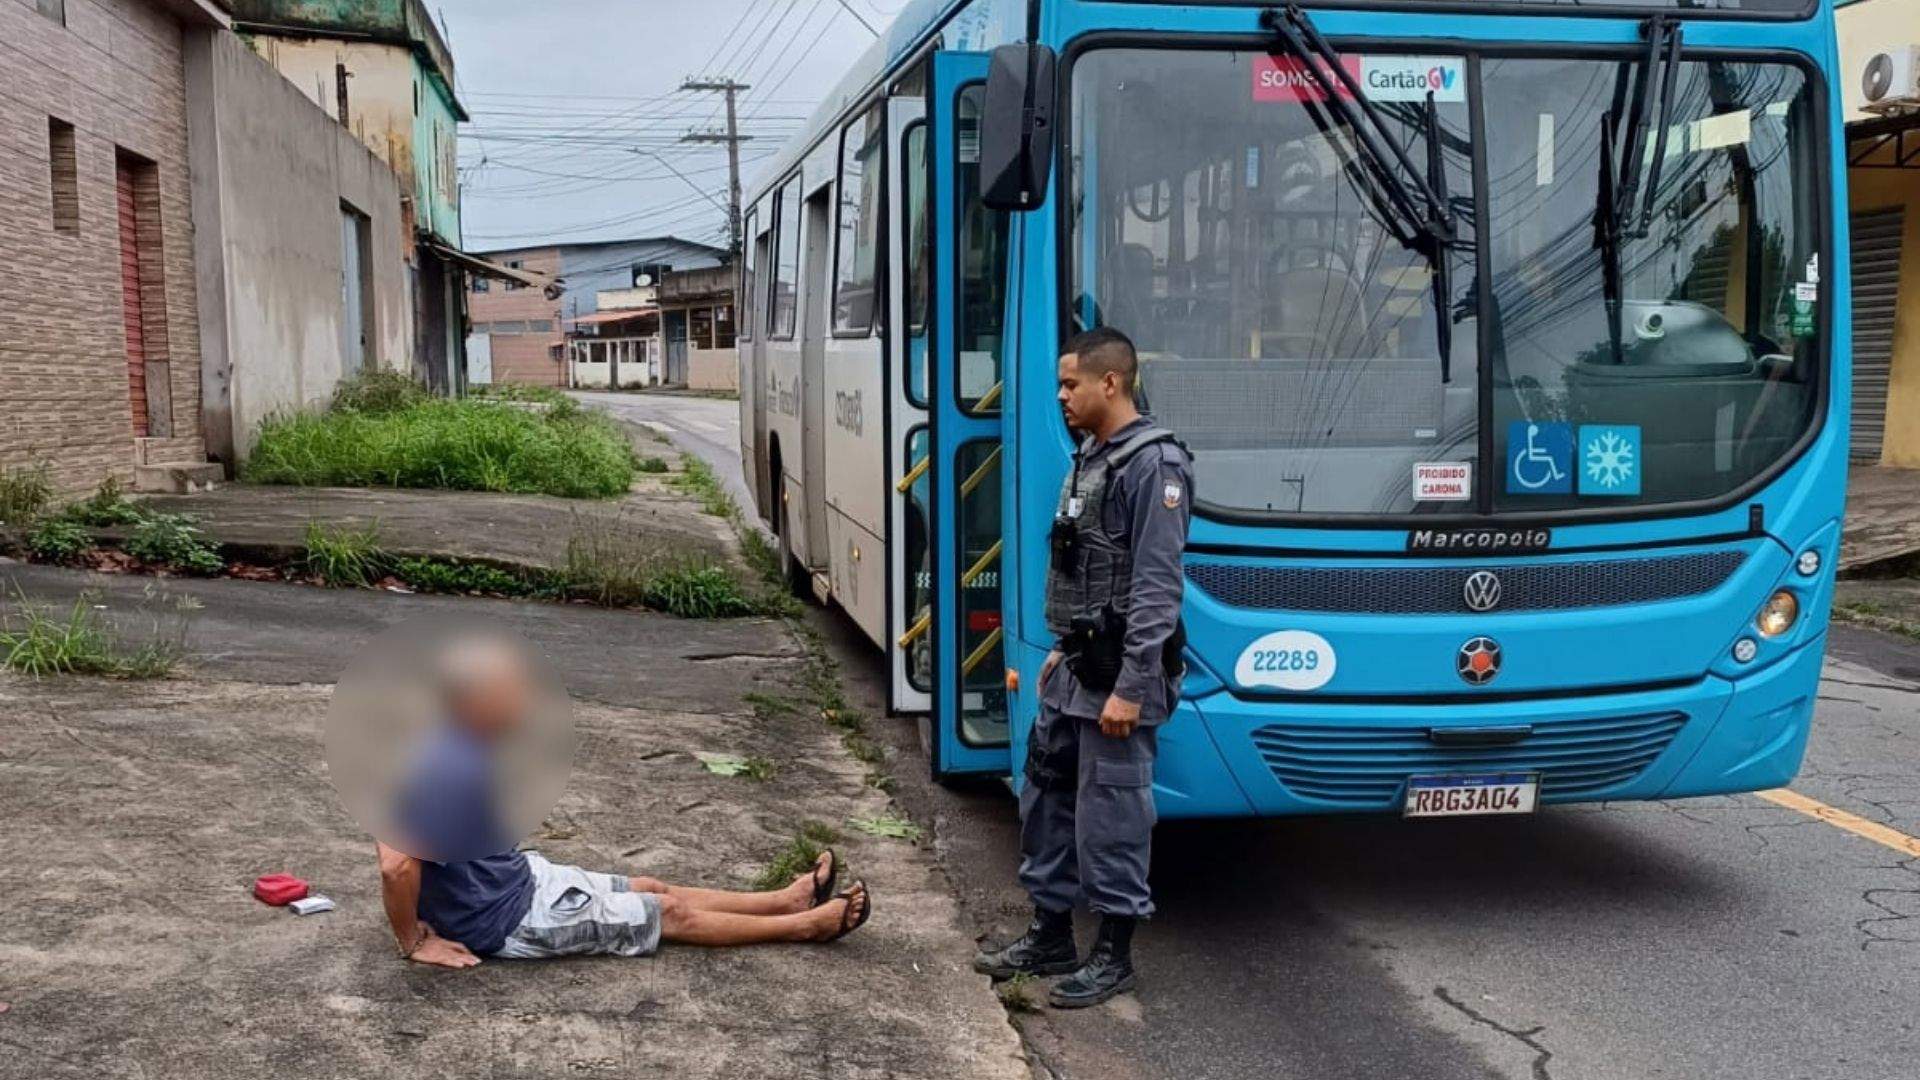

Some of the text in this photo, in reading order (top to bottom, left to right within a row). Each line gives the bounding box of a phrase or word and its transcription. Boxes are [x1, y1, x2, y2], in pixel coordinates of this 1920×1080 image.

[1261, 69, 1352, 88] SOMET
[1418, 467, 1465, 479] PROIBIDO
[1421, 483, 1462, 493] CARONA
[1412, 530, 1549, 548] Marcopolo
[1253, 649, 1319, 671] 22289
[1416, 787, 1520, 812] RBG3A04
